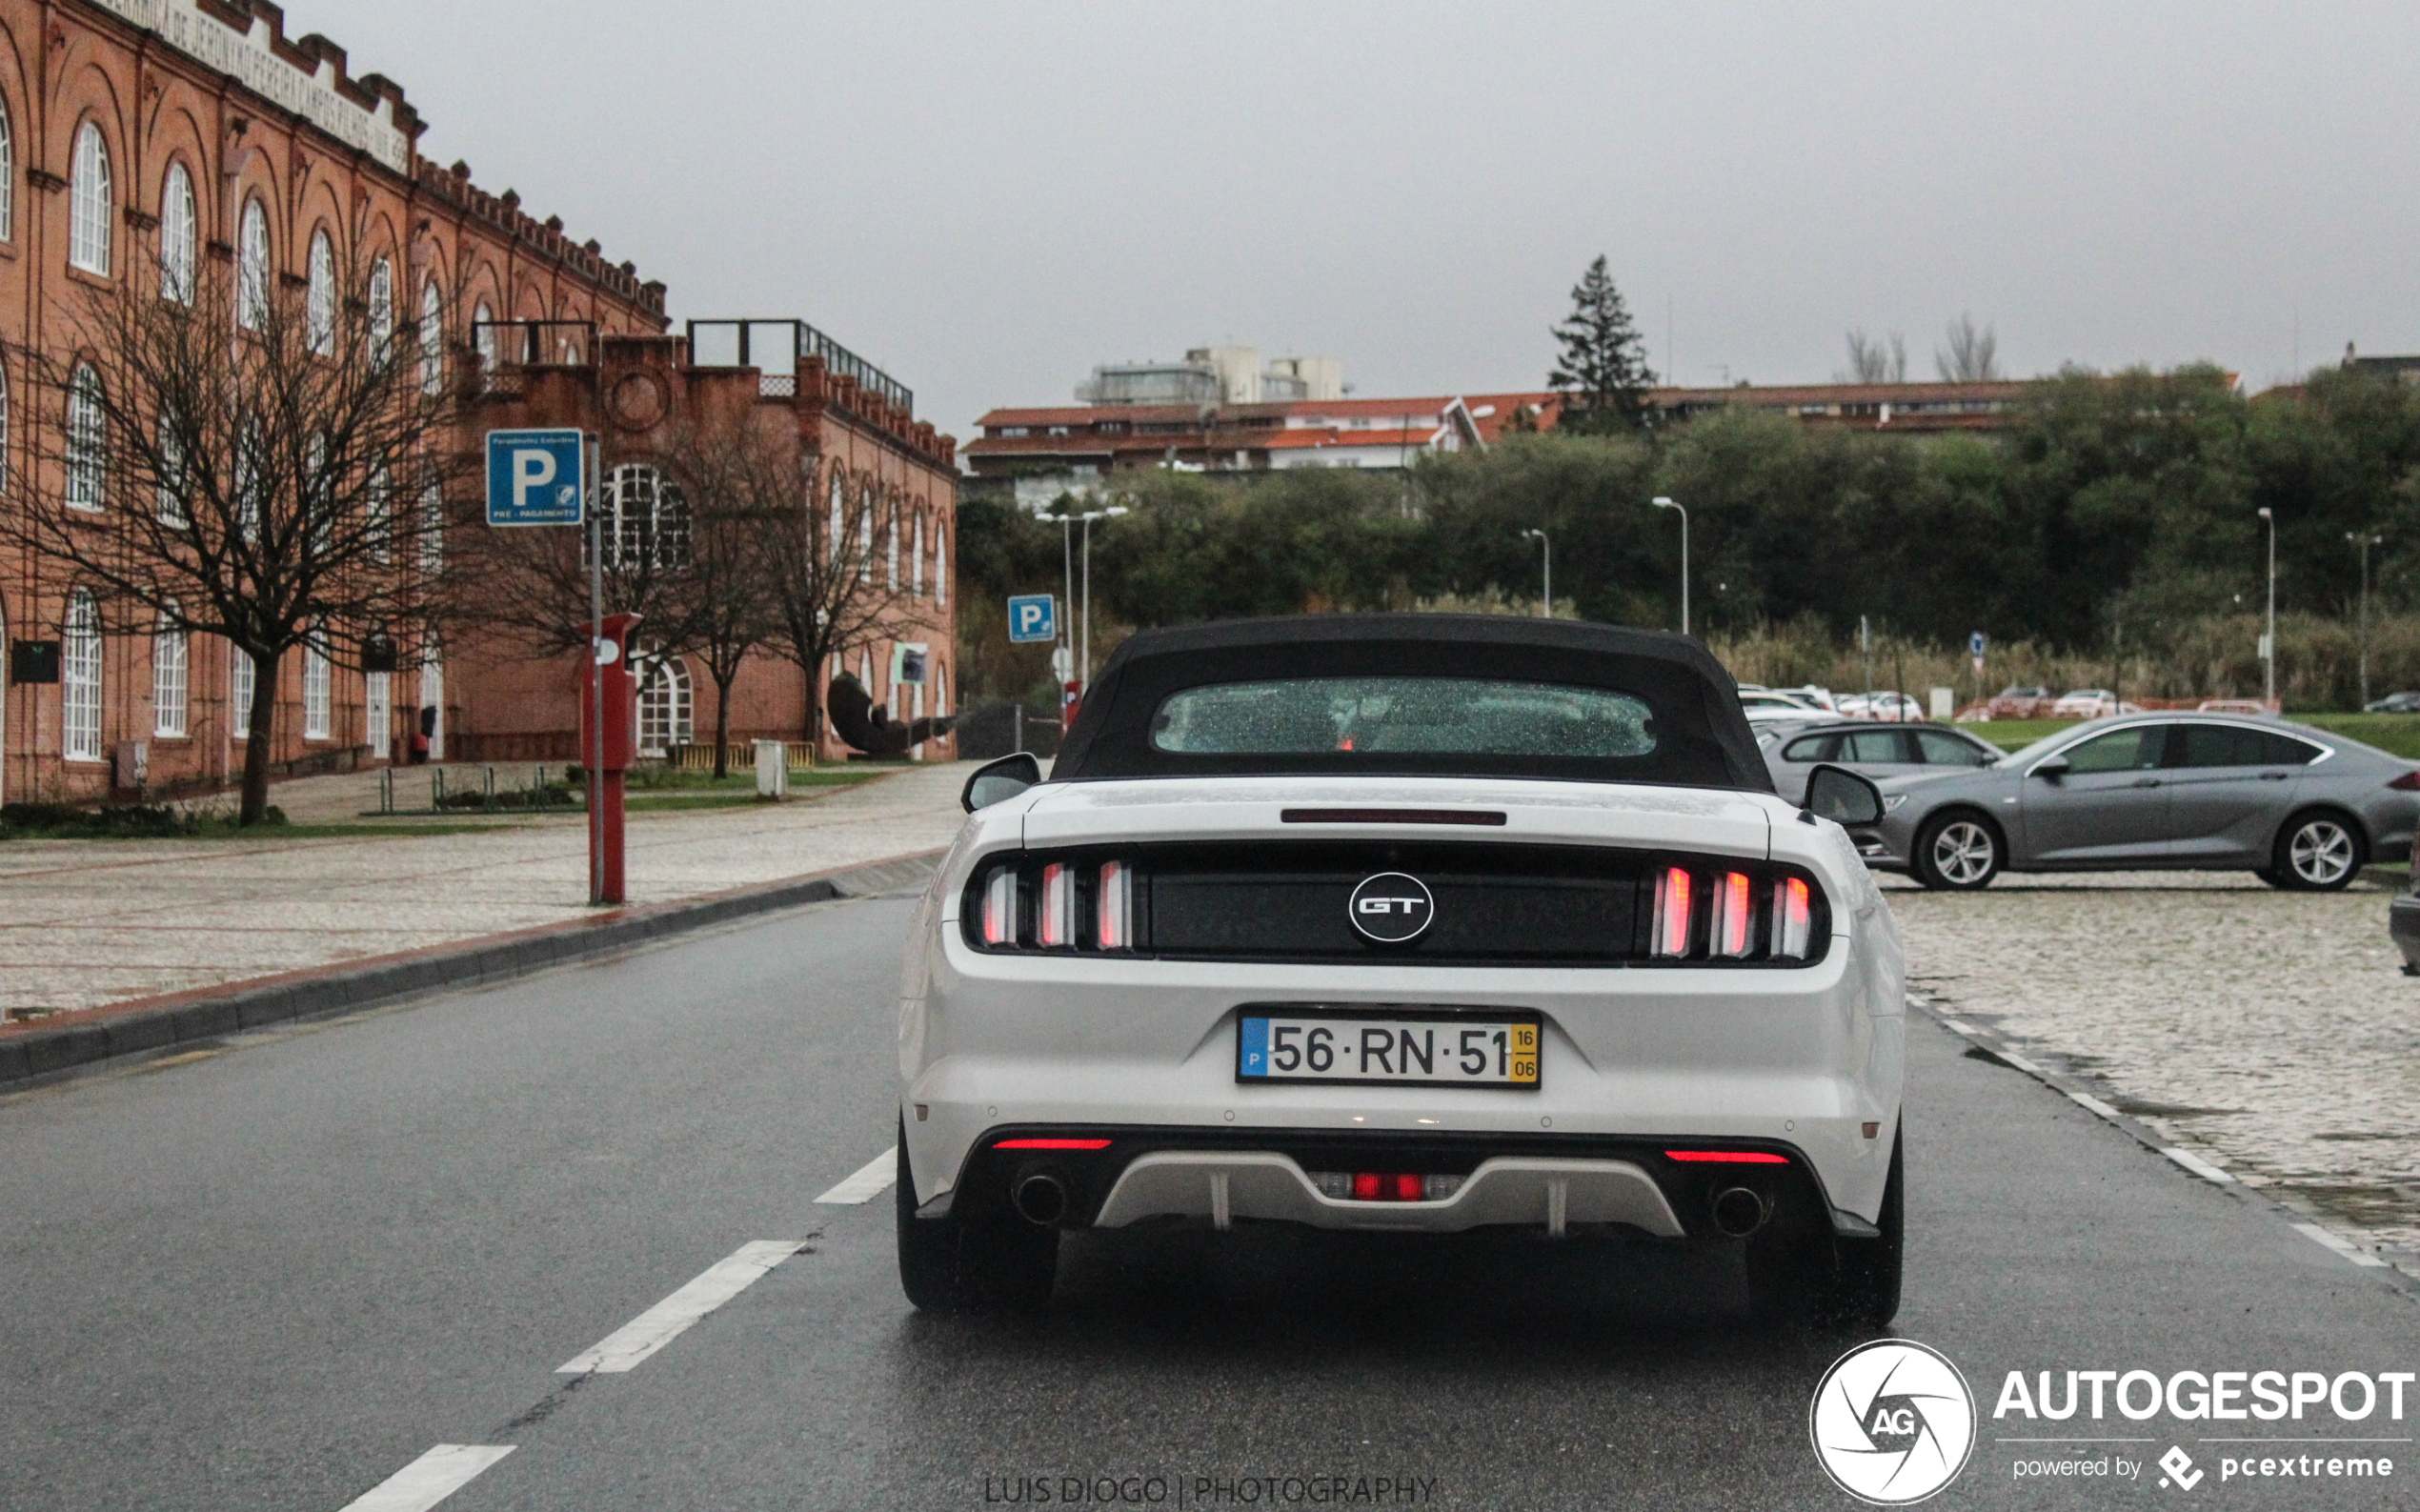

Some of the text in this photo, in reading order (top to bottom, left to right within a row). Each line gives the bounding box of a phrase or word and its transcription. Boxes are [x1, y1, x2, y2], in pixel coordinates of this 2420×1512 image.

[173, 10, 187, 46] DE
[513, 449, 556, 506] P
[520, 509, 576, 517] PAGAMENTO
[1020, 606, 1041, 632] P
[1359, 897, 1424, 914] GT
[1518, 1031, 1534, 1046] 16
[1249, 1053, 1260, 1066] P
[1515, 1061, 1535, 1077] 06
